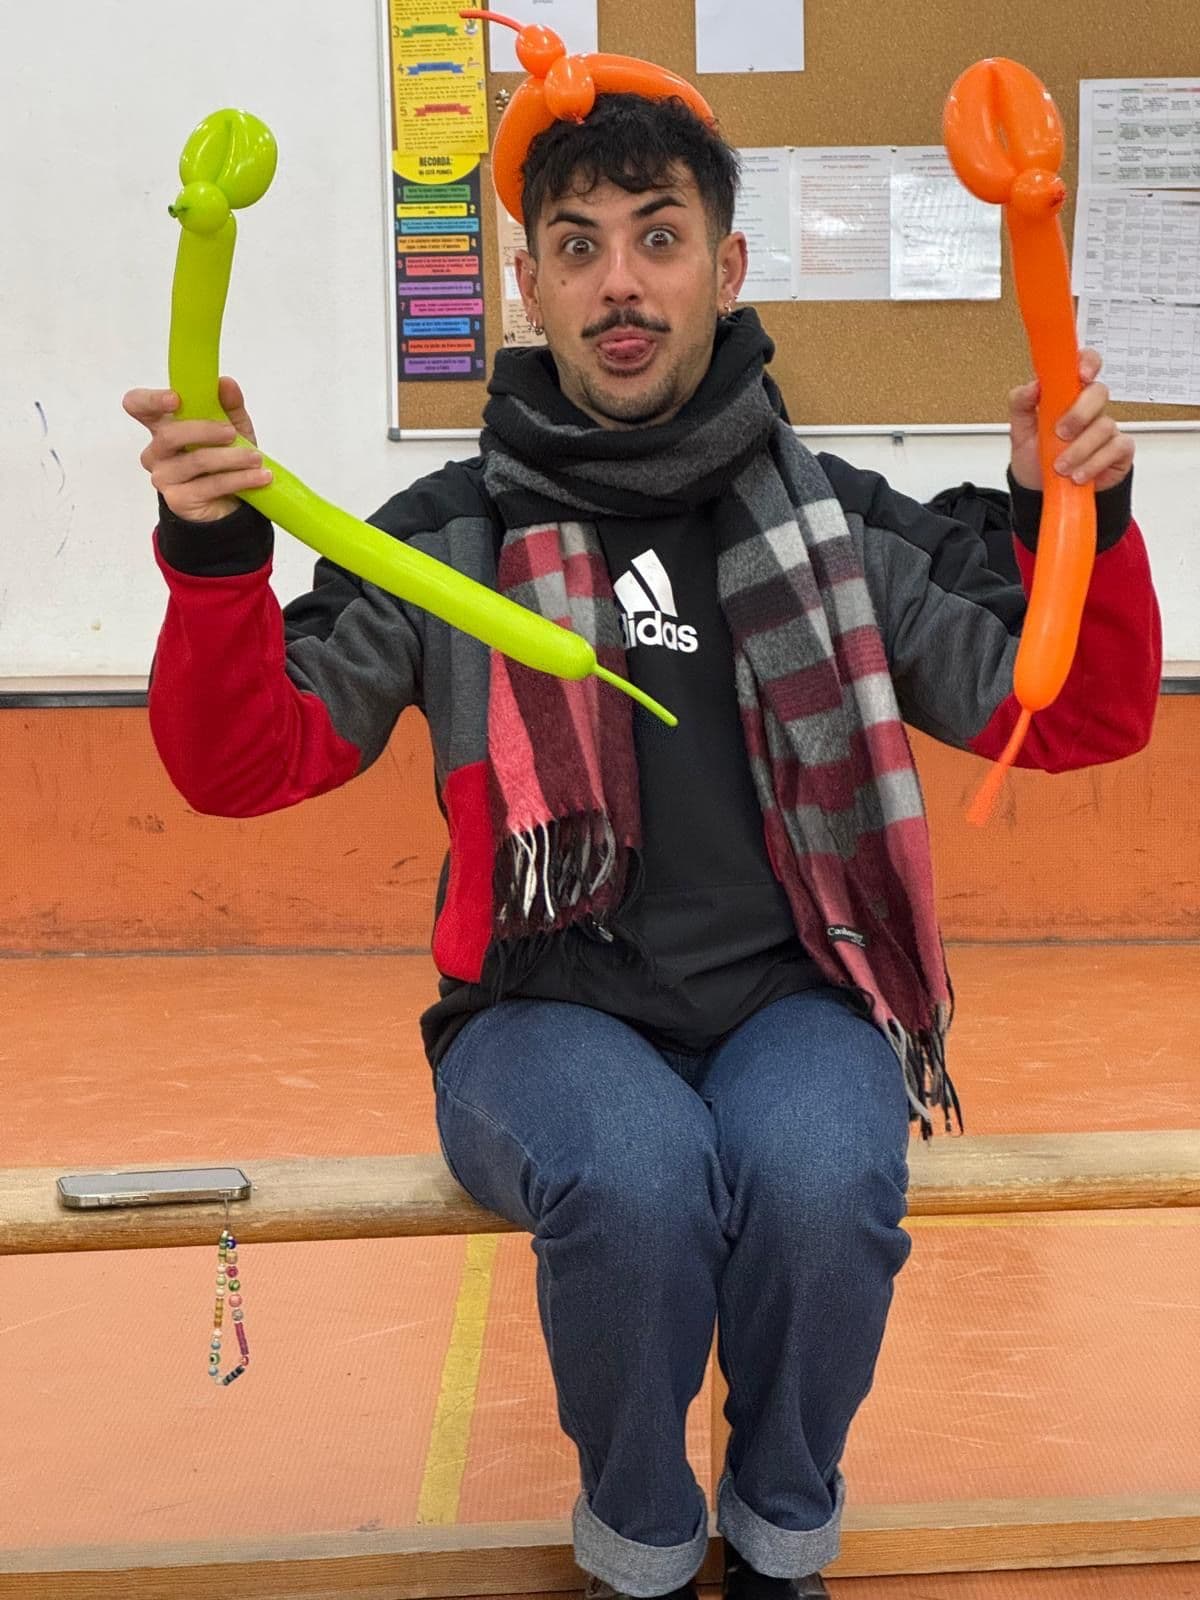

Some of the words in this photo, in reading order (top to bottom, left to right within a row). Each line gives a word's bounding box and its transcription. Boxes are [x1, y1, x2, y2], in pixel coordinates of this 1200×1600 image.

[392, 25, 400, 38] 3
[400, 105, 408, 117] 5
[621, 609, 699, 653] idas
